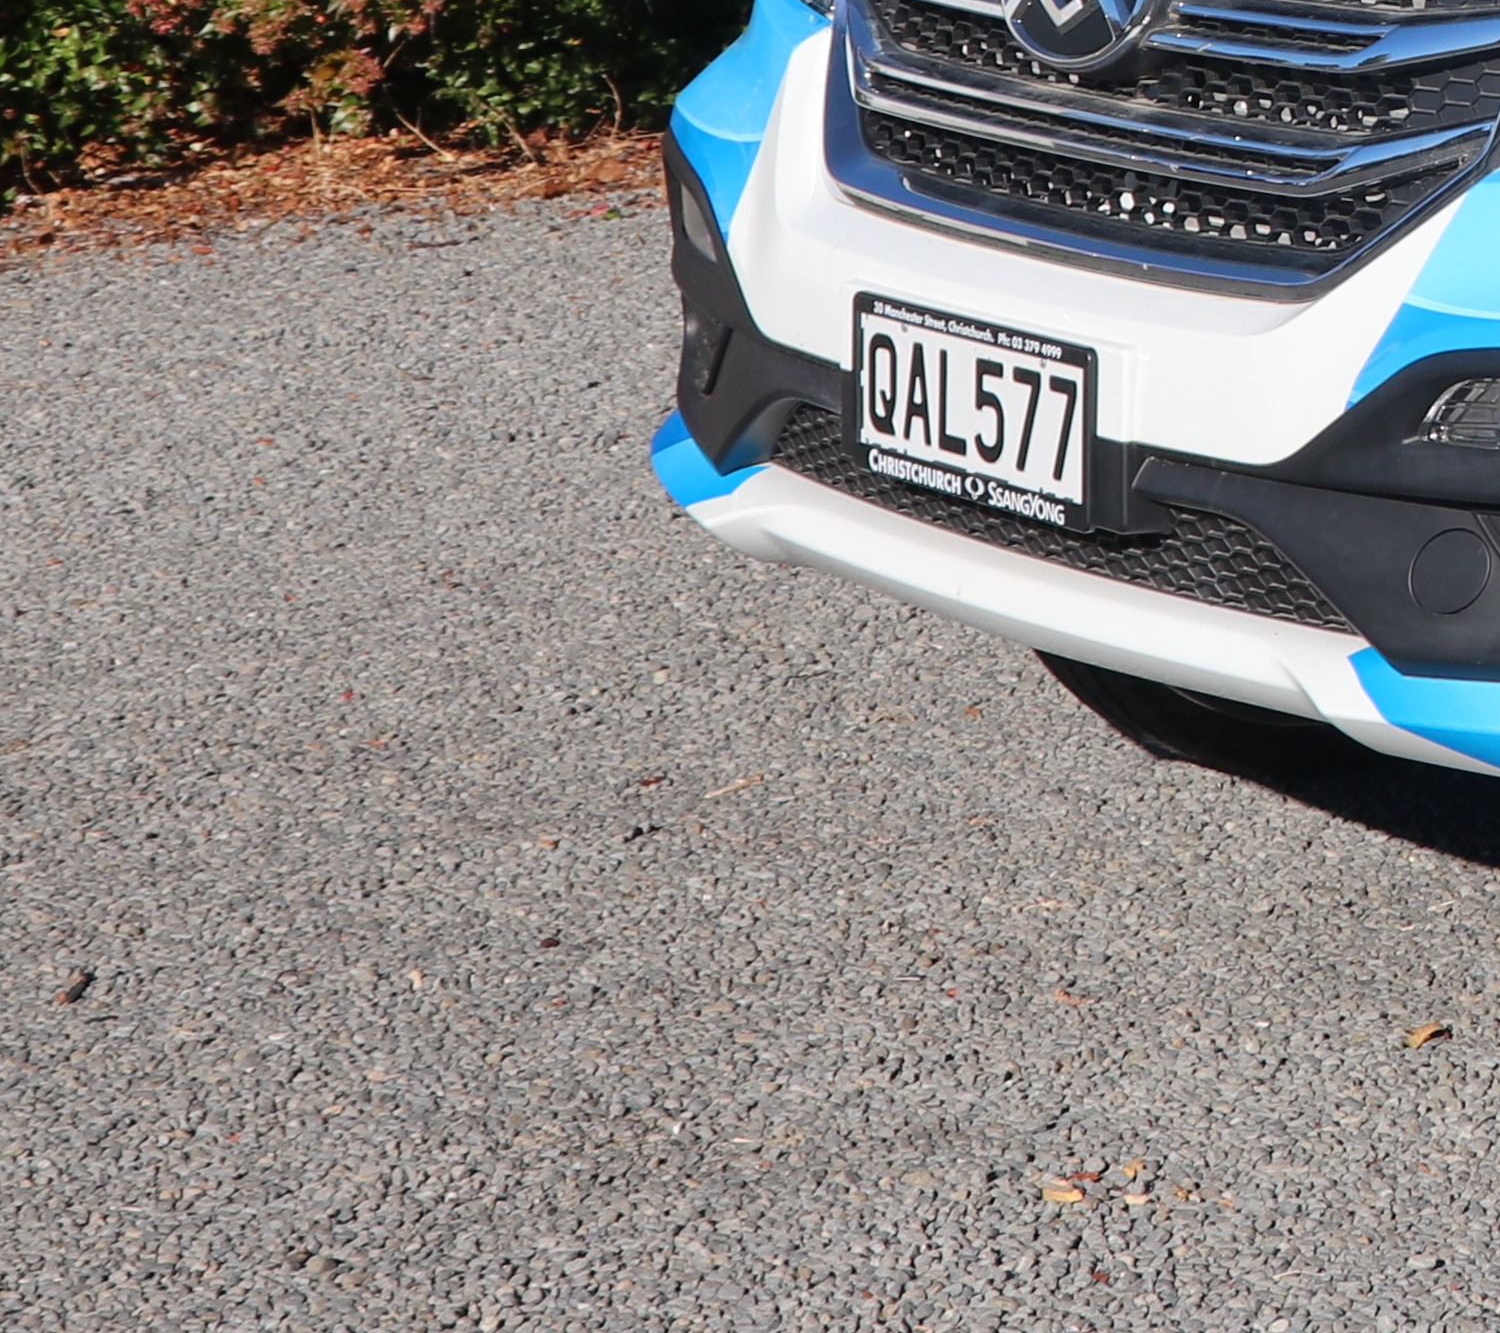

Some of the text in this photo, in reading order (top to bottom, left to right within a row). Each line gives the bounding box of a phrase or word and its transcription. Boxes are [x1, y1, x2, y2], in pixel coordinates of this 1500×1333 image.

[884, 303, 924, 326] Manchester
[924, 313, 947, 333] Street,
[947, 318, 994, 343] Christchurch.
[997, 332, 1011, 347] Ph:
[1011, 335, 1023, 350] 03
[1023, 338, 1040, 355] 379
[1040, 342, 1062, 360] 4999
[868, 332, 1078, 482] QAL577
[867, 448, 962, 496] CHRISTCHURCH
